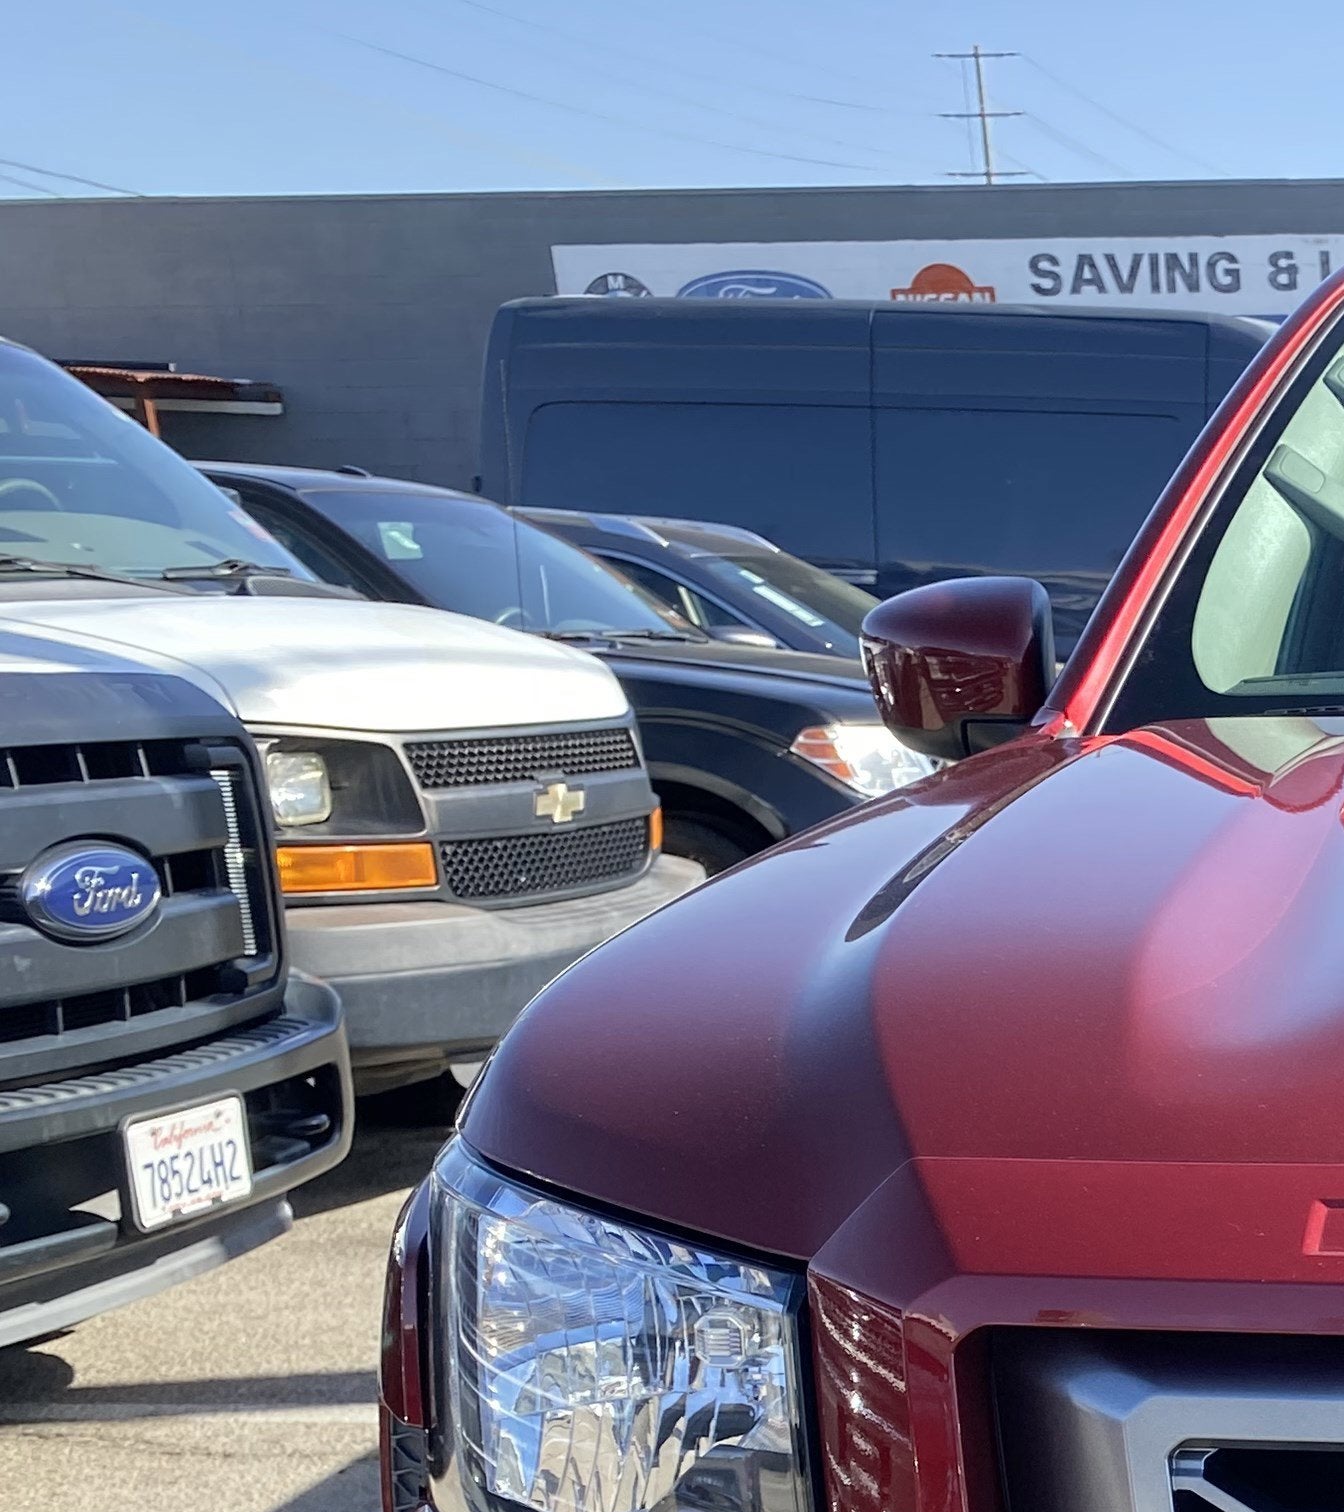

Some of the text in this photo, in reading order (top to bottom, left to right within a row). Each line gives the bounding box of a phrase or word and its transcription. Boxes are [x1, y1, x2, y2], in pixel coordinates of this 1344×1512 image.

[1028, 251, 1240, 296] SAVING
[1267, 250, 1299, 291] &
[73, 865, 142, 917] Ford
[143, 1139, 242, 1209] 78524H2
